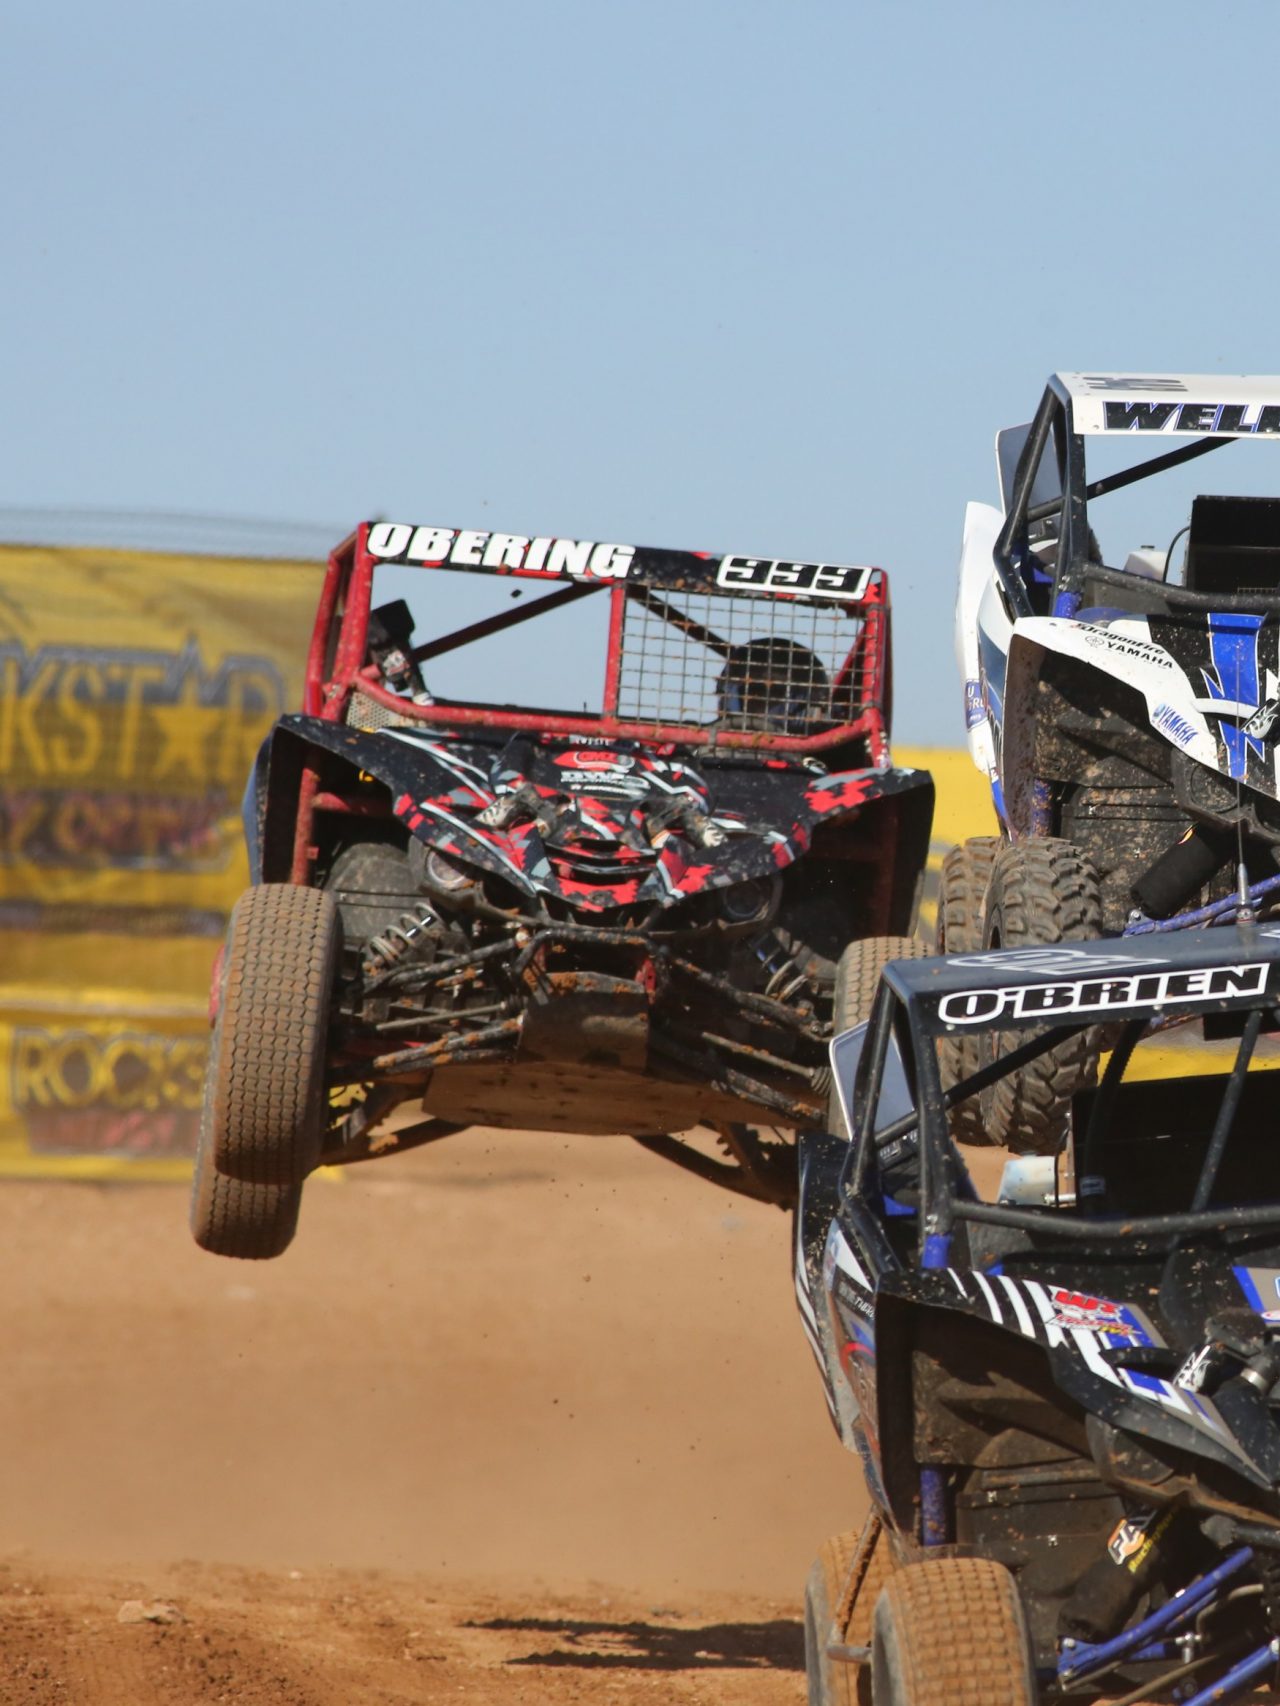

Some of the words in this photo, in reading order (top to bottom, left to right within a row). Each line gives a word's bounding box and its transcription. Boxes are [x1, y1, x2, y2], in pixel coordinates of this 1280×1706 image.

[367, 522, 636, 579] OBERING
[725, 557, 865, 593] 999
[1107, 641, 1174, 669] YAMAHA
[1159, 705, 1199, 746] YAMAHA
[940, 963, 1270, 1024] O'BRIEN
